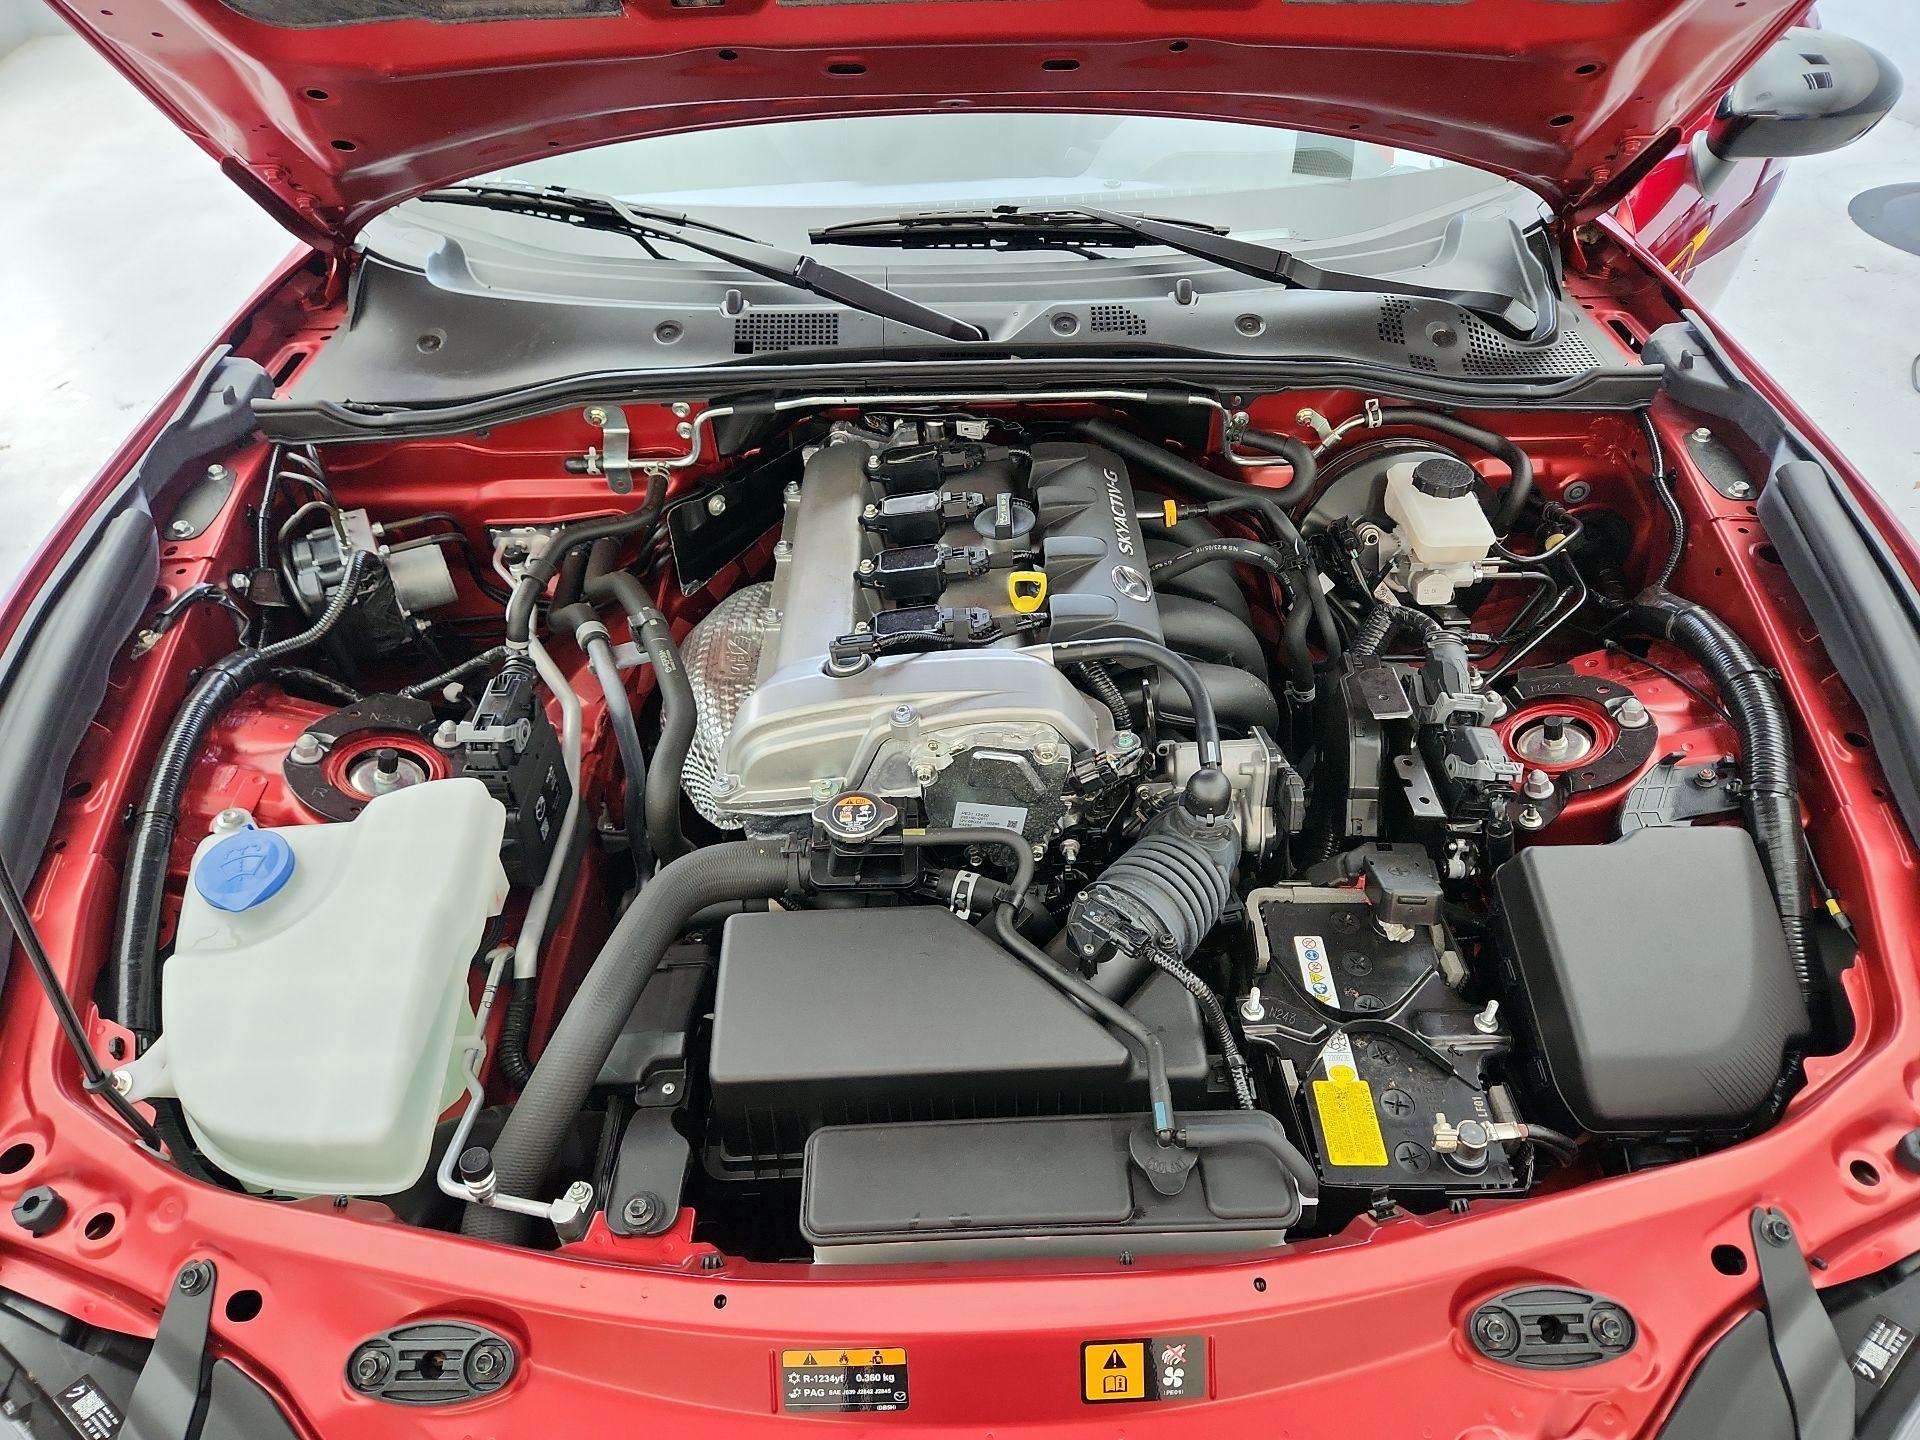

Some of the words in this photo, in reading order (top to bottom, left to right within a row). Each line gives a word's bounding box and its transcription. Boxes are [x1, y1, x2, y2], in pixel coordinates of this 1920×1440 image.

[1102, 469, 1135, 557] SKYACTIV-G
[803, 1374, 845, 1384] R-1234yf
[855, 1373, 881, 1383] 0.360
[882, 1373, 895, 1384] kg
[803, 1389, 825, 1397] PAG
